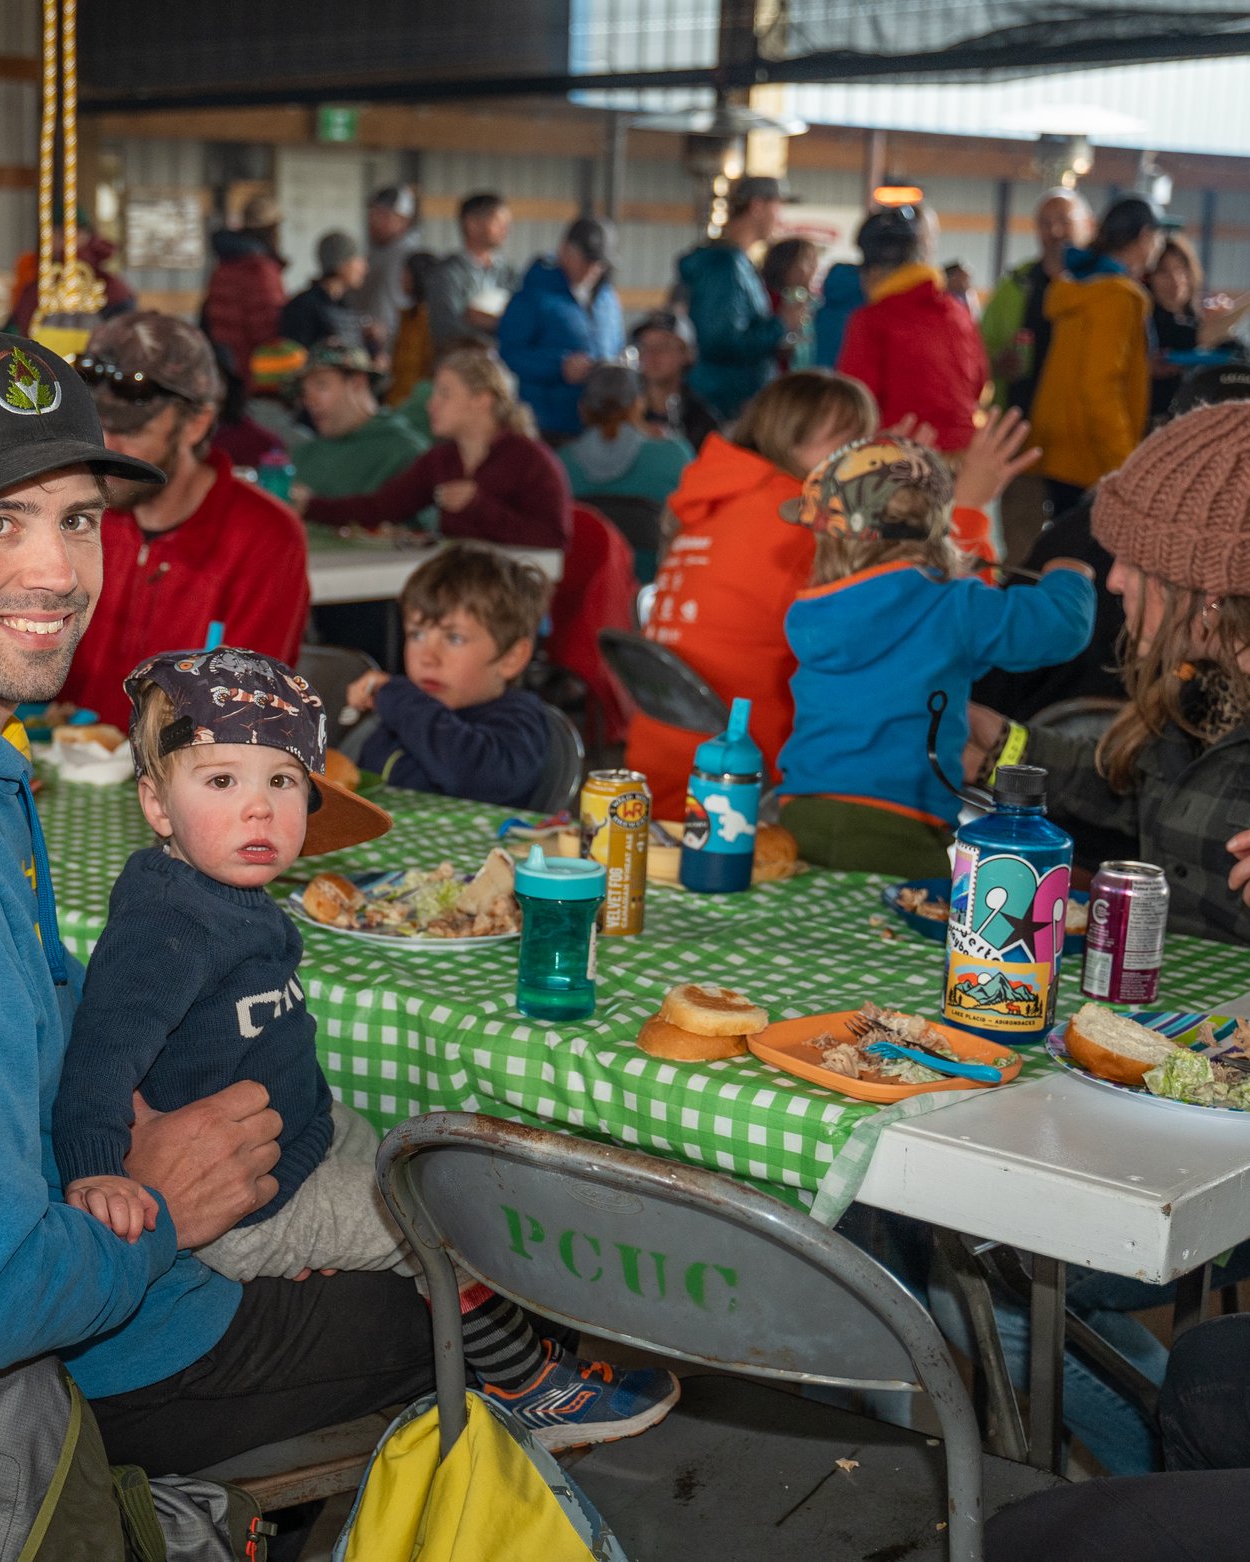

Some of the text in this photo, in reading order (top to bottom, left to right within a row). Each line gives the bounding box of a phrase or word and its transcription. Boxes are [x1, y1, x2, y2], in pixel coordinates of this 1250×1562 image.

[606, 867, 623, 929] VELVET FOG
[951, 1009, 964, 1018] LAKE
[965, 1013, 987, 1023] PLACID
[994, 1019, 1036, 1027] ADIRONDACKS
